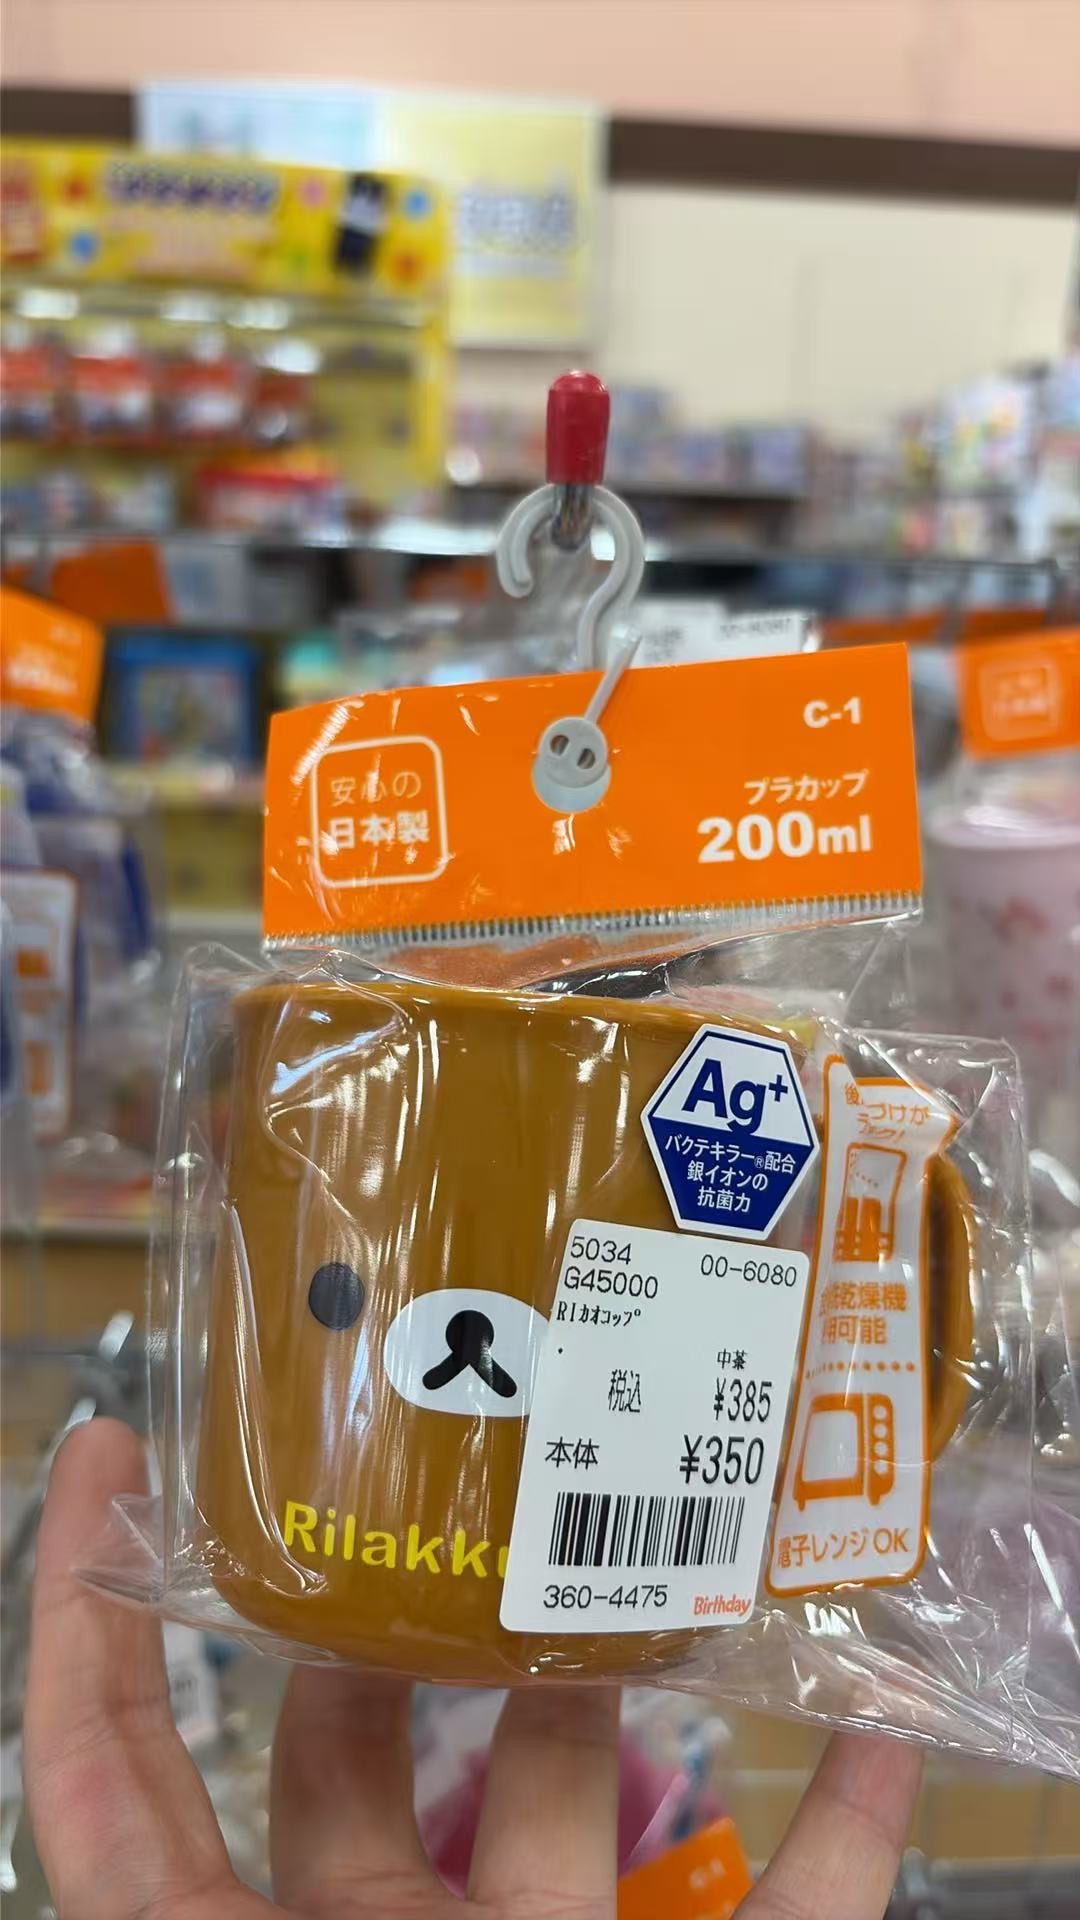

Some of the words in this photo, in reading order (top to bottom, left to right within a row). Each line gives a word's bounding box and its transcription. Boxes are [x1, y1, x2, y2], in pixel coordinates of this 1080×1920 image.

[803, 697, 861, 728] C-1
[331, 772, 422, 807] 安心の
[744, 768, 869, 805] プラカップ
[329, 810, 430, 849] 日本製
[697, 811, 871, 863] 200ml
[682, 1058, 788, 1134] Ag+
[687, 1160, 768, 1191] 銀イオンの
[697, 1186, 751, 1213] 抗菌力
[570, 1236, 631, 1265] 5034
[564, 1266, 658, 1299] G45000
[701, 1254, 797, 1287] 00-6080
[608, 1369, 641, 1413] 税込
[714, 1377, 772, 1422] ¥385
[545, 1436, 600, 1470] 本体
[680, 1434, 765, 1484] ¥350
[543, 1584, 668, 1609] 360-4475
[693, 1594, 750, 1617] Birthday
